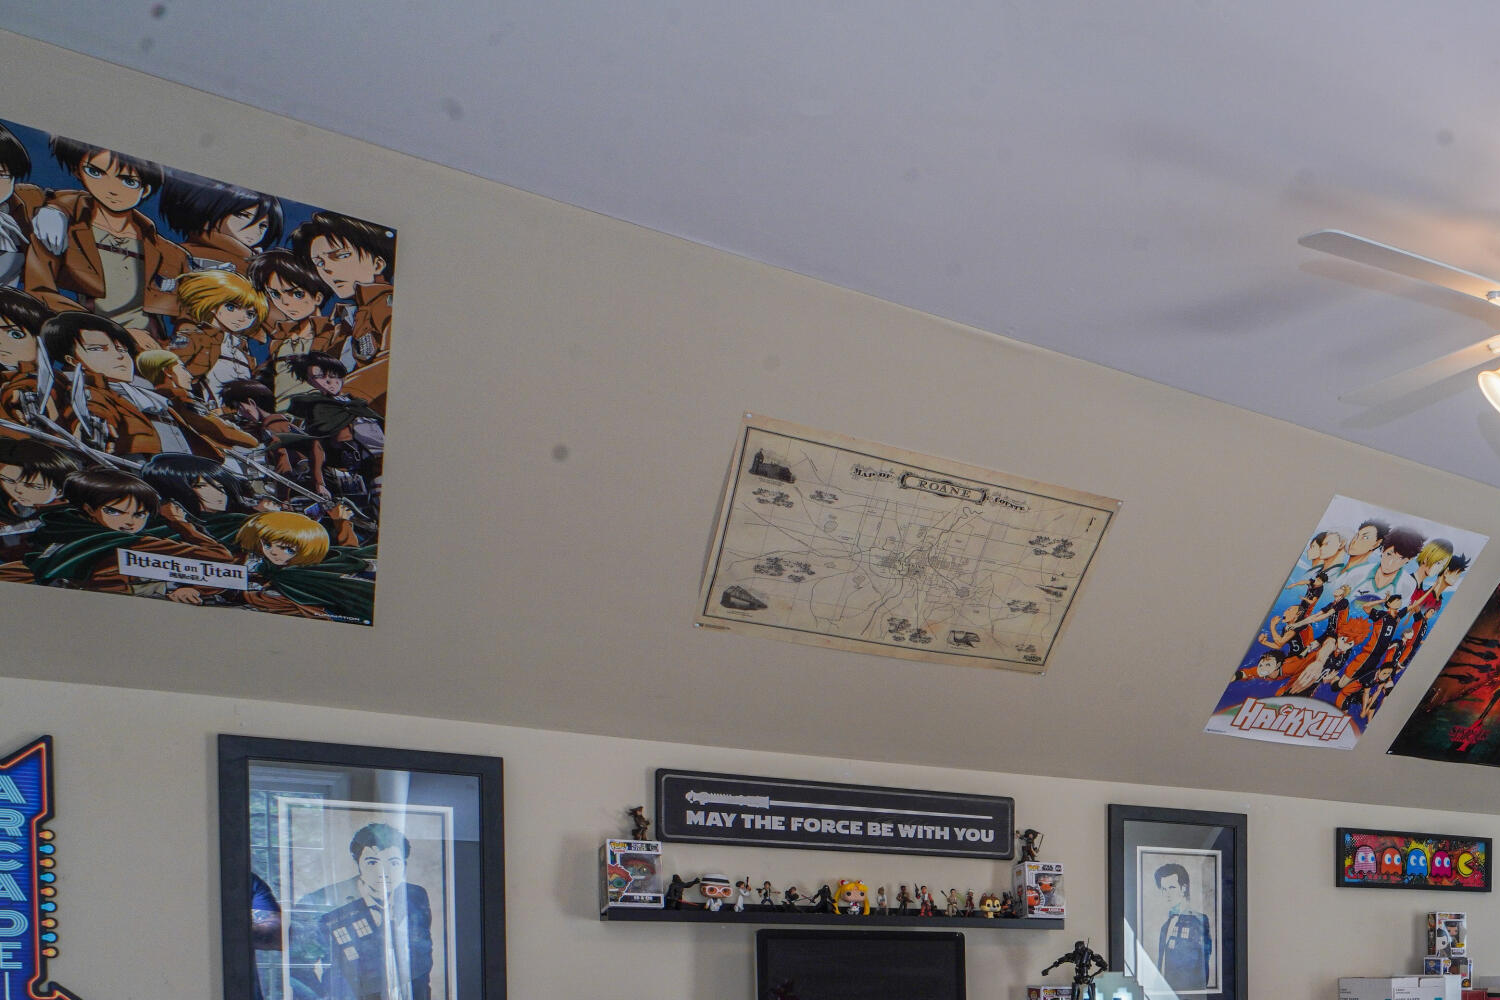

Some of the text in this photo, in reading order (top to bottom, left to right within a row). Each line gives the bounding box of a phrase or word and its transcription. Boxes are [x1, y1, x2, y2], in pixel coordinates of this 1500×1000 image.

[918, 480, 971, 498] ROANE
[126, 551, 182, 573] Attack
[184, 565, 198, 573] on
[200, 562, 243, 579] Titan
[1292, 639, 1300, 652] 5
[686, 810, 996, 843] MAY THE FORCE BE WITH YOU
